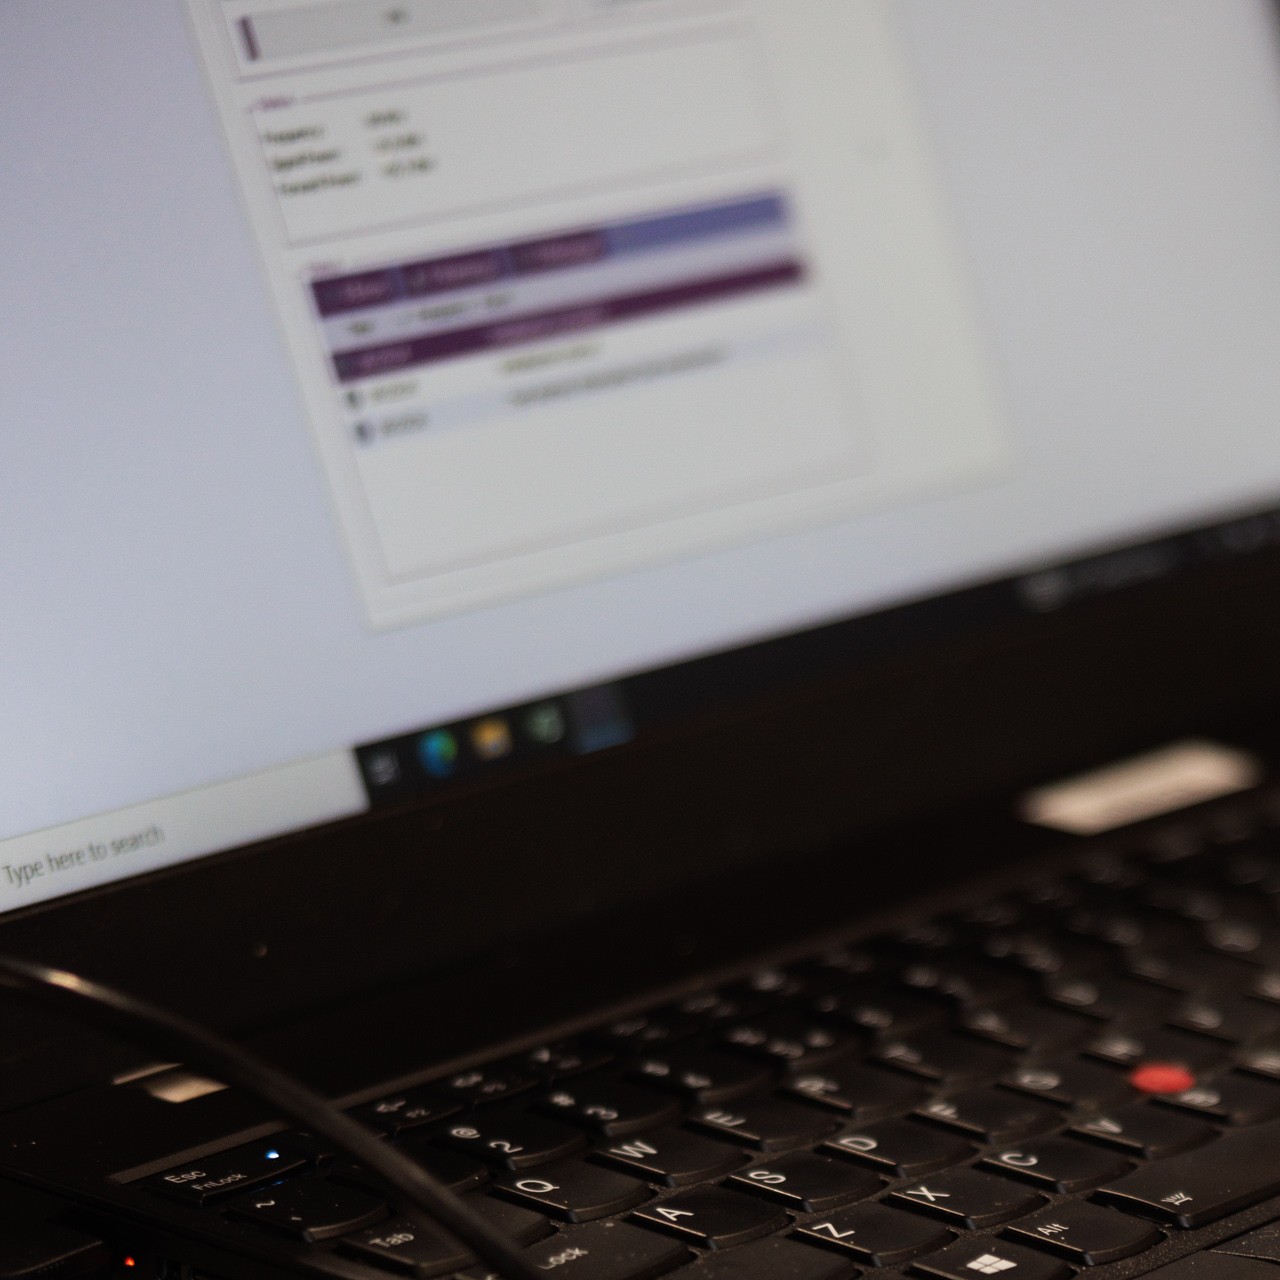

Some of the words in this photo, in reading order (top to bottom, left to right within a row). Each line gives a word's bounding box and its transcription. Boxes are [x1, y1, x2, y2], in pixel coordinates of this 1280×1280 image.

[2, 860, 44, 889] Type
[46, 849, 86, 873] here
[88, 842, 108, 861] to
[110, 825, 166, 856] search
[609, 1140, 659, 1159] W
[164, 1170, 208, 1184] Esc
[749, 1170, 787, 1184] S
[515, 1179, 561, 1193] Q
[906, 1186, 951, 1202] X
[655, 1207, 695, 1221] A
[811, 1222, 856, 1238] Z
[1036, 1222, 1069, 1237] Alt
[368, 1232, 415, 1249] Tab
